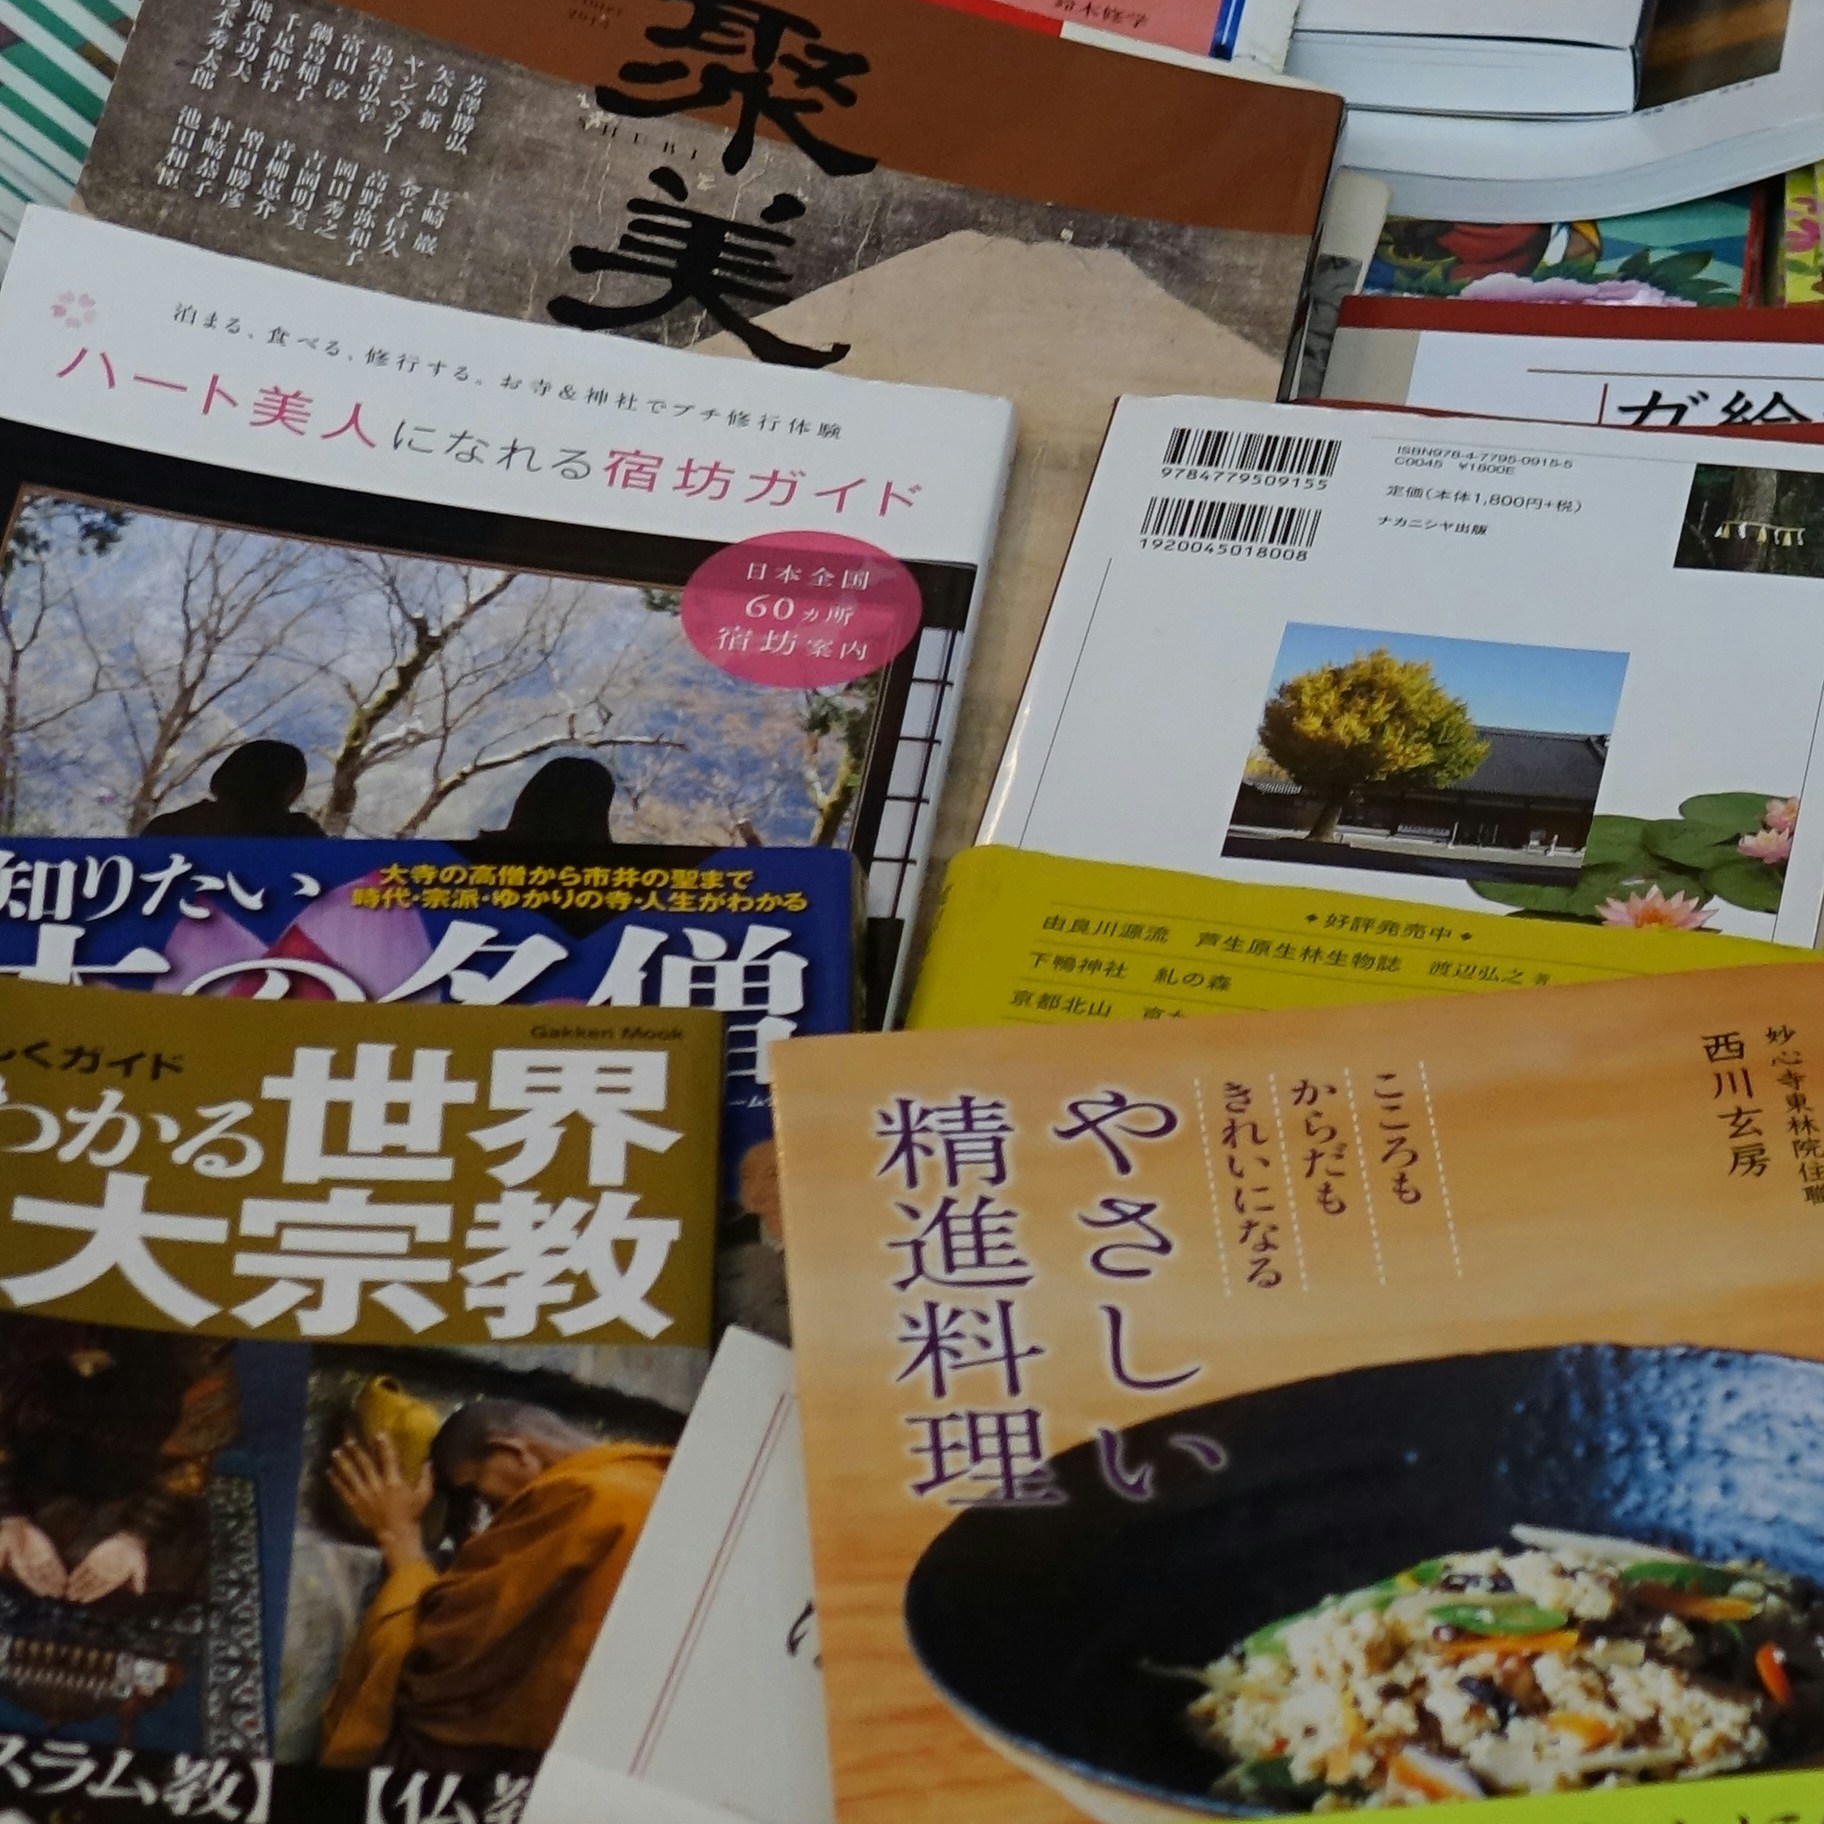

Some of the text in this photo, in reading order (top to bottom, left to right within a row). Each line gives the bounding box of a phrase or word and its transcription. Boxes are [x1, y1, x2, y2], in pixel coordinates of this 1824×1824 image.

[55, 344, 925, 520] ハート美人になれる宿坊ガイド
[1159, 465, 1330, 492] 9784779509155
[1376, 513, 1490, 538] ナカニシヤ出版
[1138, 535, 1310, 564] 1920045018008
[742, 559, 873, 593] 日本全国
[715, 624, 870, 666] 宿坊案内
[378, 862, 756, 891] 大寺の高僧から市井の聖まで
[1042, 912, 1171, 945] 由良川源流
[1323, 912, 1455, 945] 好評発売中
[1027, 947, 1129, 980] 下鴨神社
[1007, 987, 1114, 1020] 京都北山
[530, 1023, 686, 1044] Gakken Mook
[1700, 1029, 1774, 1179] 西川玄房
[1287, 1075, 1350, 1219] からだも
[1370, 1071, 1424, 1208] こころも
[1218, 1079, 1286, 1292] きれいになる
[0, 1170, 686, 1341] 大宗教
[874, 1092, 1070, 1511] 精進料理
[1052, 1084, 1230, 1504] やさしい
